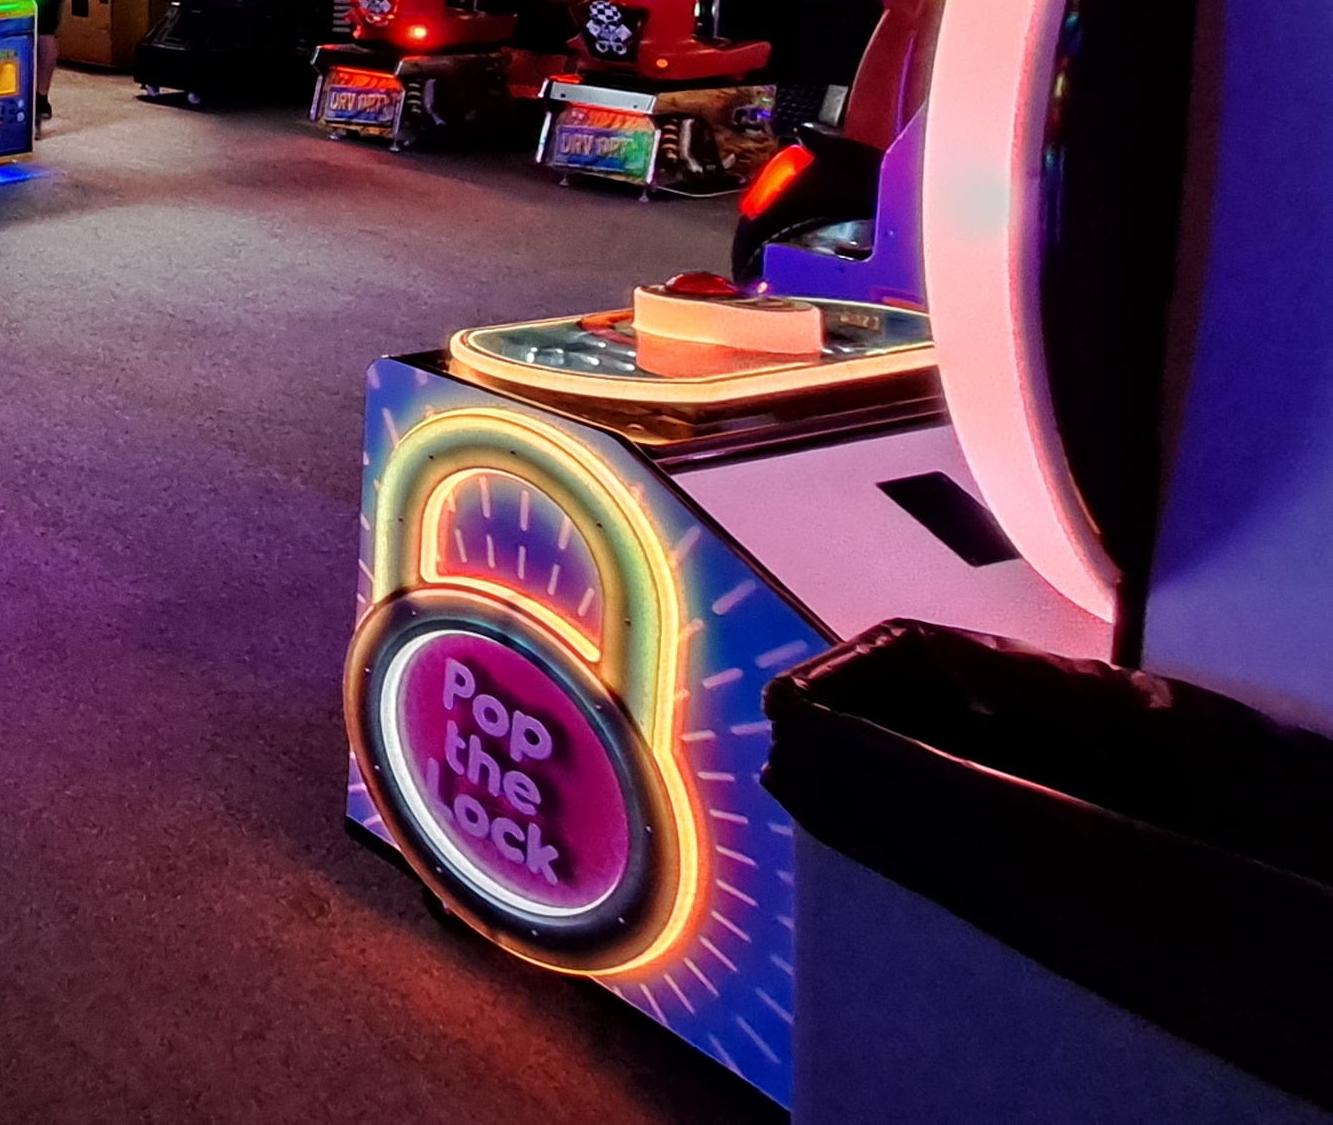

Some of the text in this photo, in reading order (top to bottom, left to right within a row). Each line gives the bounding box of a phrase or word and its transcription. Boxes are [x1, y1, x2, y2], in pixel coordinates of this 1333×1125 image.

[443, 657, 553, 763] Pop
[444, 686, 541, 814] the
[427, 756, 561, 884] Lock
